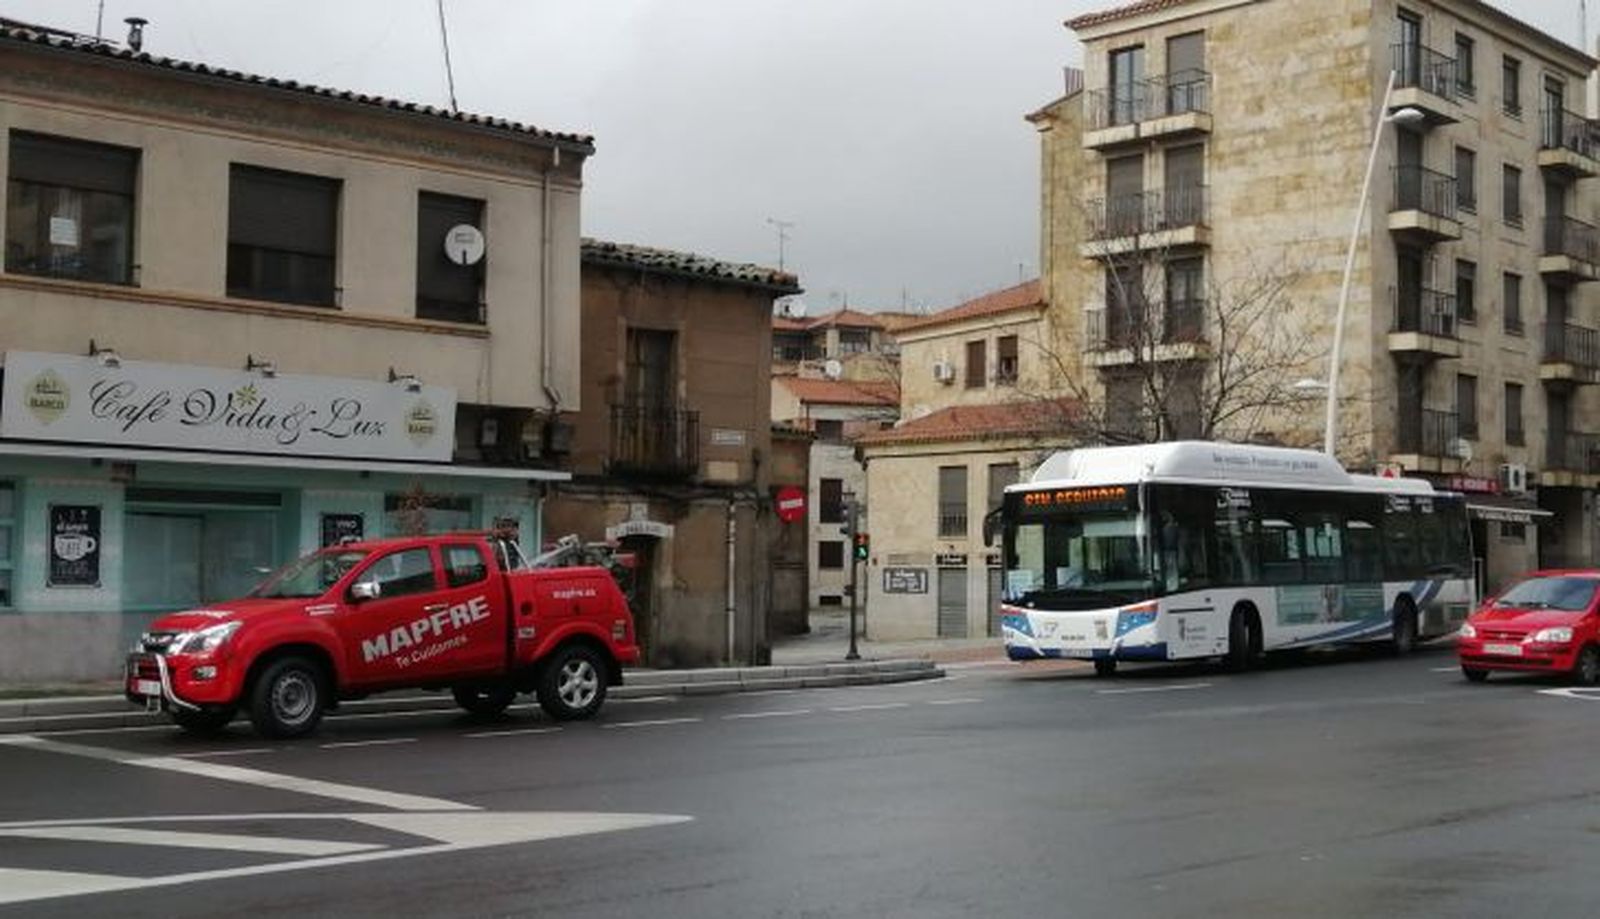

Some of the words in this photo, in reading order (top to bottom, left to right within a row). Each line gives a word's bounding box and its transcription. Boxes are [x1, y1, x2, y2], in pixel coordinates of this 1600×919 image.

[89, 380, 171, 432] Café
[180, 388, 277, 427] Vida
[276, 402, 317, 445] &
[310, 397, 387, 439] Luz
[362, 595, 491, 663] MAPFRE
[395, 654, 412, 668] Te
